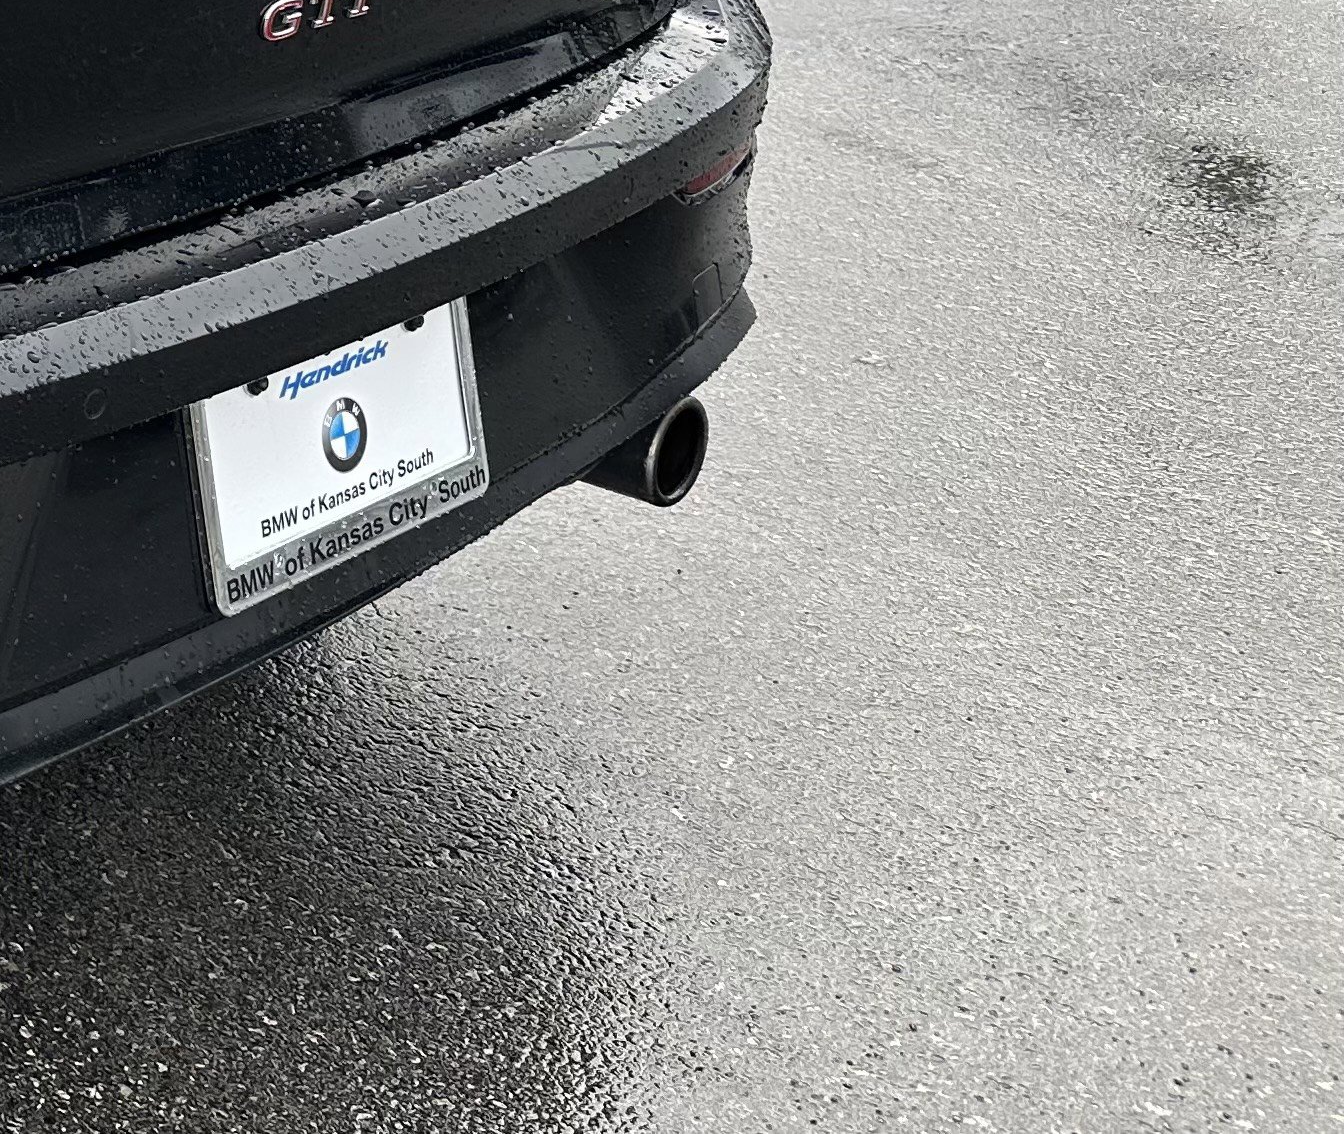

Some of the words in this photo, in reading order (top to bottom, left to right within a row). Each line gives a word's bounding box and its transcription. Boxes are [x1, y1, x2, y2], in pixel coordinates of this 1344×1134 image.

[279, 340, 389, 400] Hendrick
[226, 563, 275, 605] BMW
[285, 548, 305, 576] of
[311, 517, 384, 566] Kansas
[388, 493, 429, 525] City
[439, 465, 486, 504] South
[261, 506, 299, 538] BMW
[302, 498, 316, 520] of
[318, 480, 366, 516] Kansas
[369, 468, 395, 494] City
[398, 448, 434, 478] South
